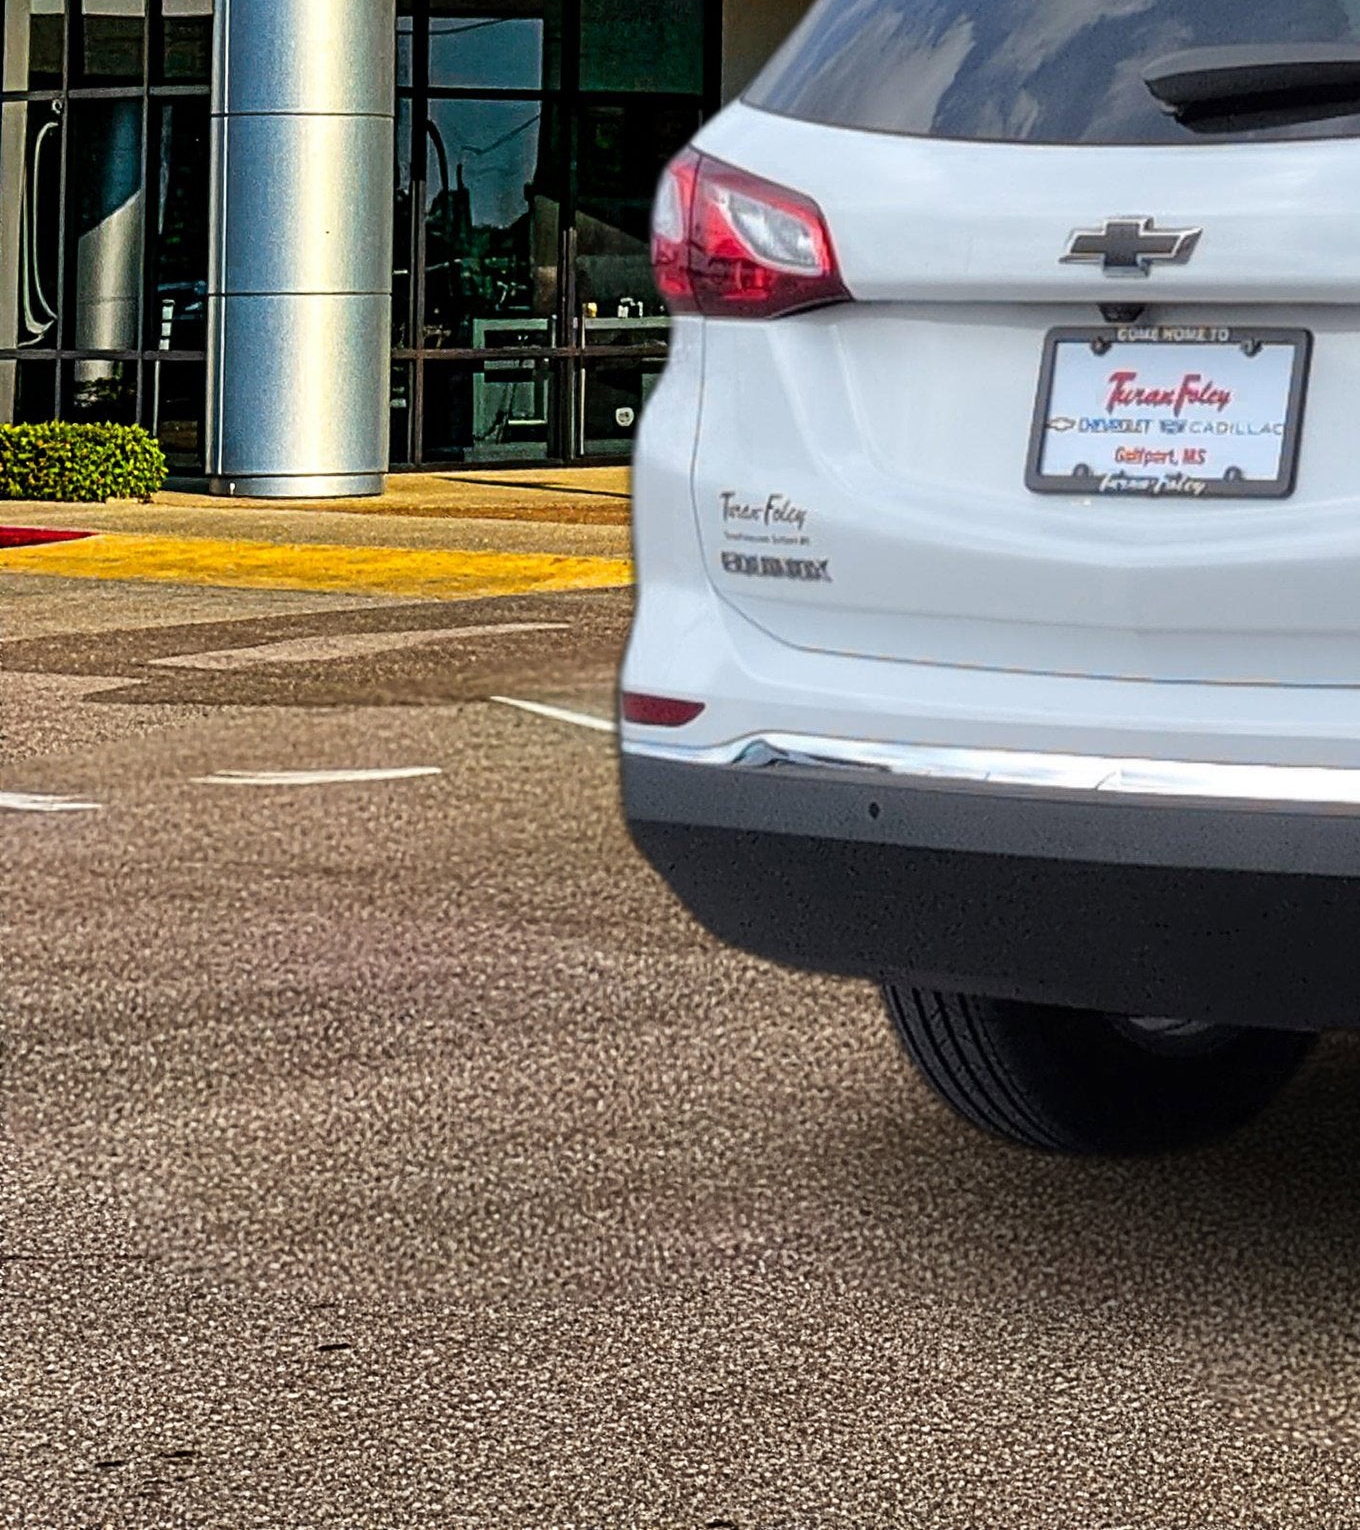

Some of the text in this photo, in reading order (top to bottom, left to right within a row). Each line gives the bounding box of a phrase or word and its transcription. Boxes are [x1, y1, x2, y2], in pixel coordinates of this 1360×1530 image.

[1078, 419, 1285, 435] CHEVROLET CADILLAC
[1183, 448, 1207, 464] MS
